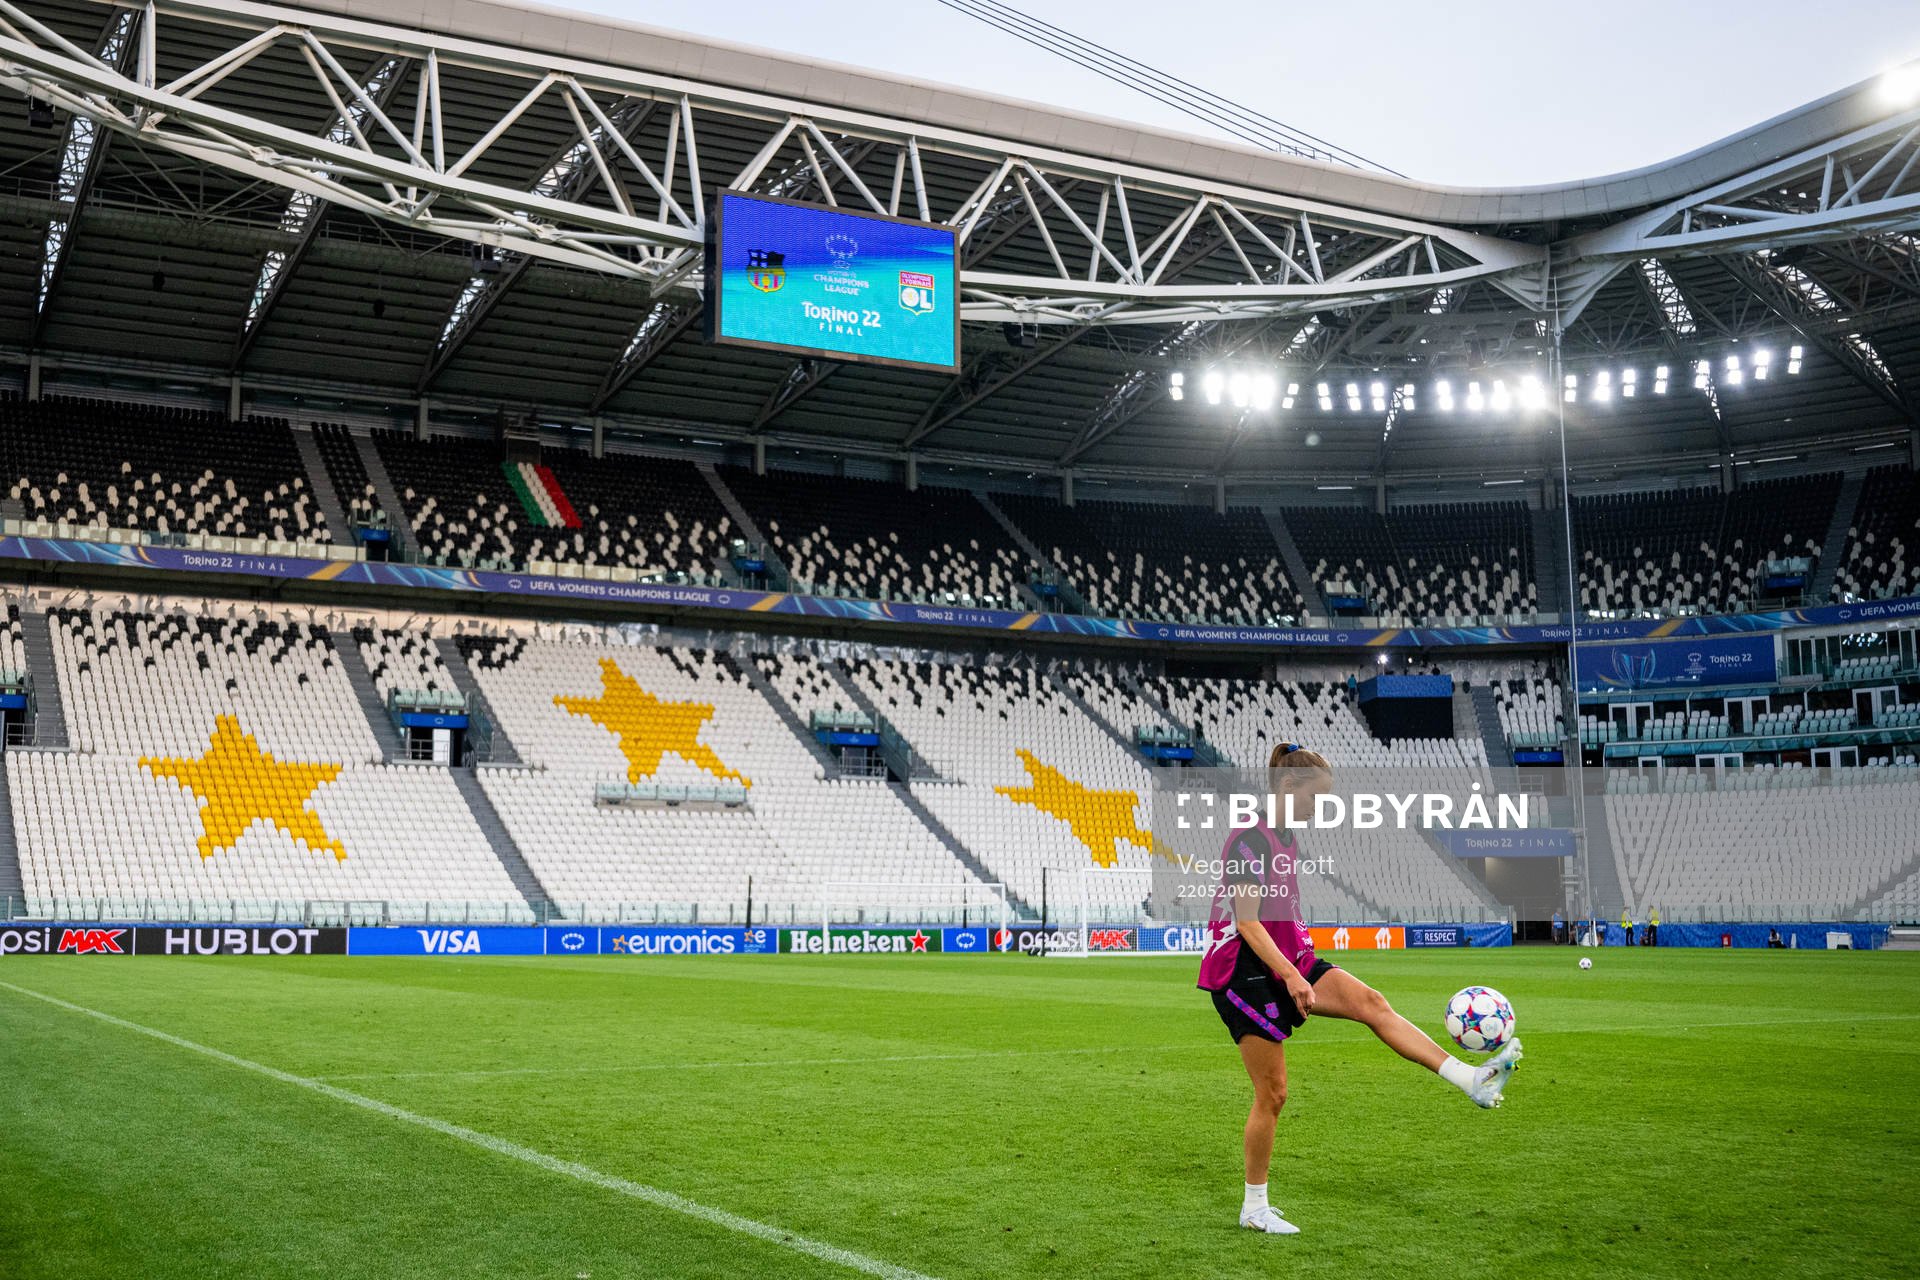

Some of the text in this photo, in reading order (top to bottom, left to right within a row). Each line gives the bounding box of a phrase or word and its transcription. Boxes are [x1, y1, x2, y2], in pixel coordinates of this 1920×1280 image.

[824, 284, 860, 295] LEAGUE
[862, 309, 881, 327] 22
[819, 322, 863, 337] FINAL
[220, 556, 233, 568] 22
[240, 560, 286, 572] FINAL
[530, 580, 711, 603] UEFA WOMEN'S CHAMPIONS LEAGUE
[944, 611, 954, 621] 22
[958, 613, 993, 624] FINAL
[1861, 606, 1886, 617] UEFA
[1175, 628, 1329, 642] UEFA WOMEN'S CHAMPIONS LEAGUE
[1588, 626, 1629, 637] FINAL
[1741, 650, 1753, 662] 22
[1500, 838, 1513, 848] 22
[1519, 838, 1566, 848] FINAL
[57, 928, 127, 954] MAX
[165, 928, 319, 954] HUBLOT
[416, 929, 481, 953] VISA
[628, 929, 735, 953] euronics
[1424, 932, 1456, 942] RESPECT
